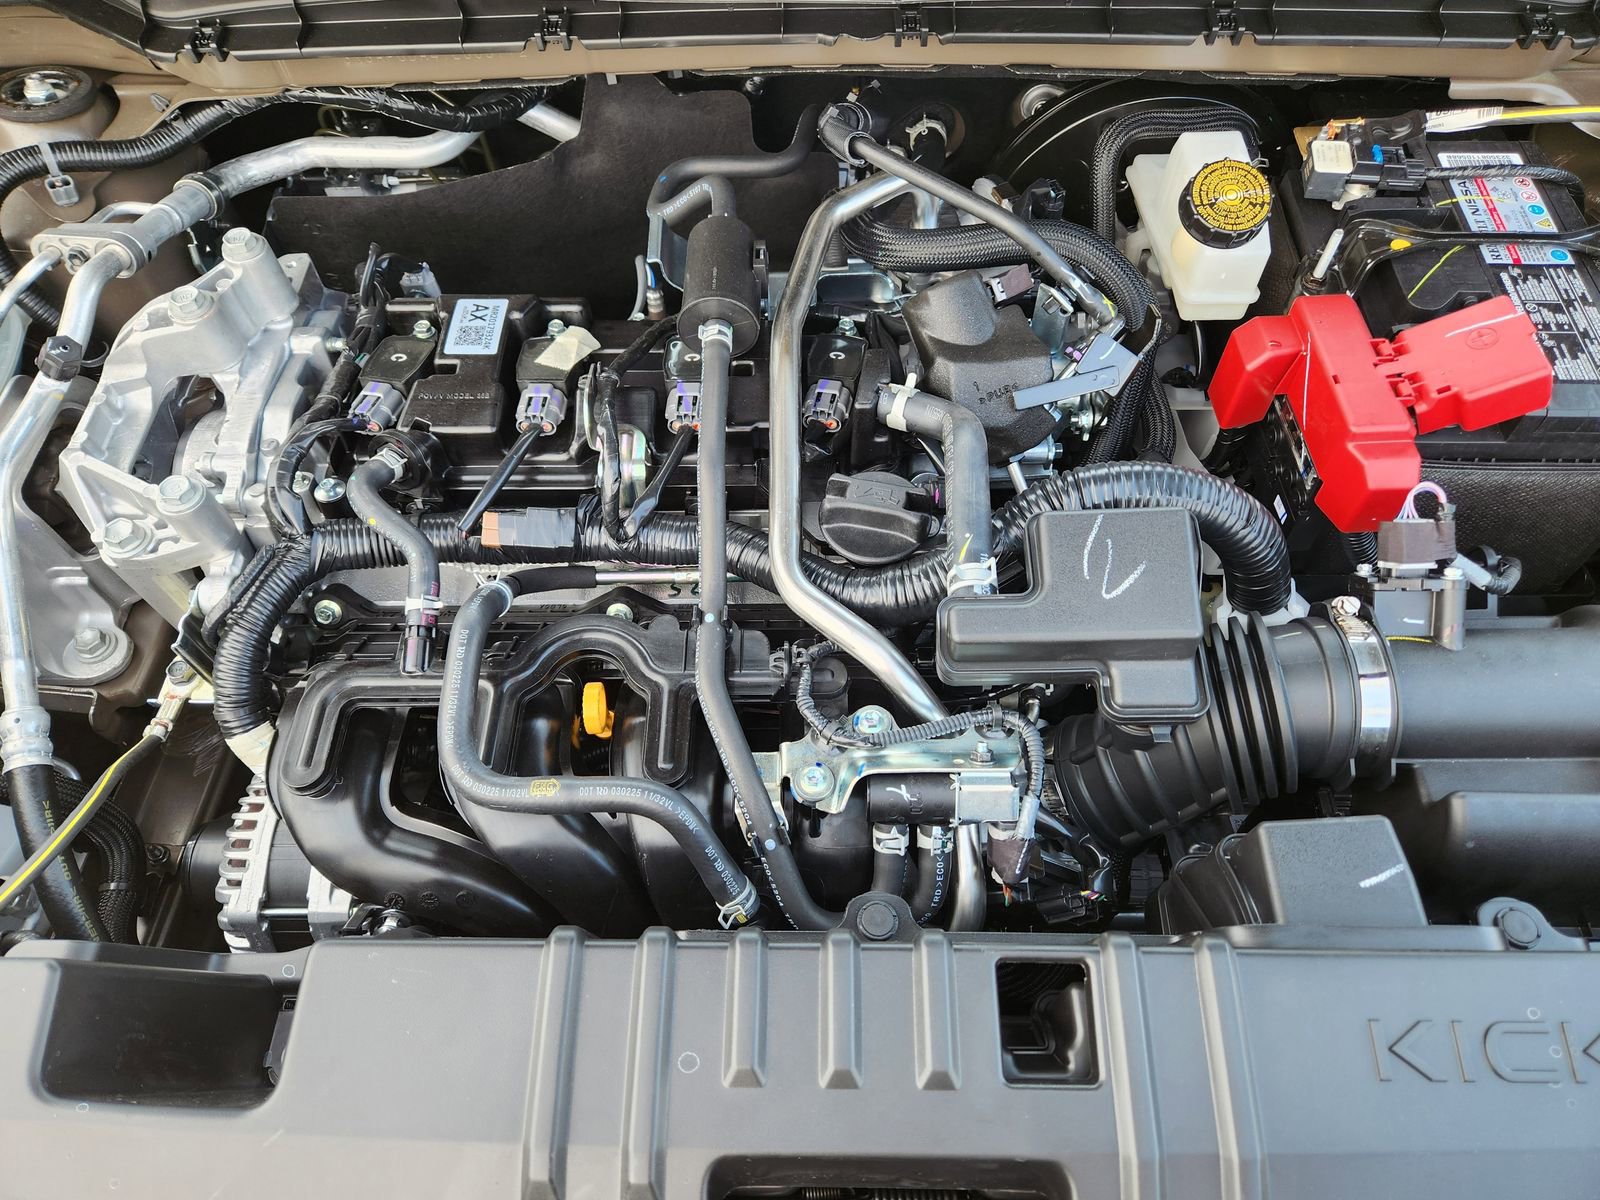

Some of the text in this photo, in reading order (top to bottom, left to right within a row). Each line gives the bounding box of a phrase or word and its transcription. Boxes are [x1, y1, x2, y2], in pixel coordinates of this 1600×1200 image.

[1458, 180, 1482, 216] NISSA
[468, 303, 490, 323] AX
[580, 787, 593, 796] DOT
[611, 786, 642, 797] 030225
[705, 845, 718, 860] DOT
[721, 870, 740, 896] 030225
